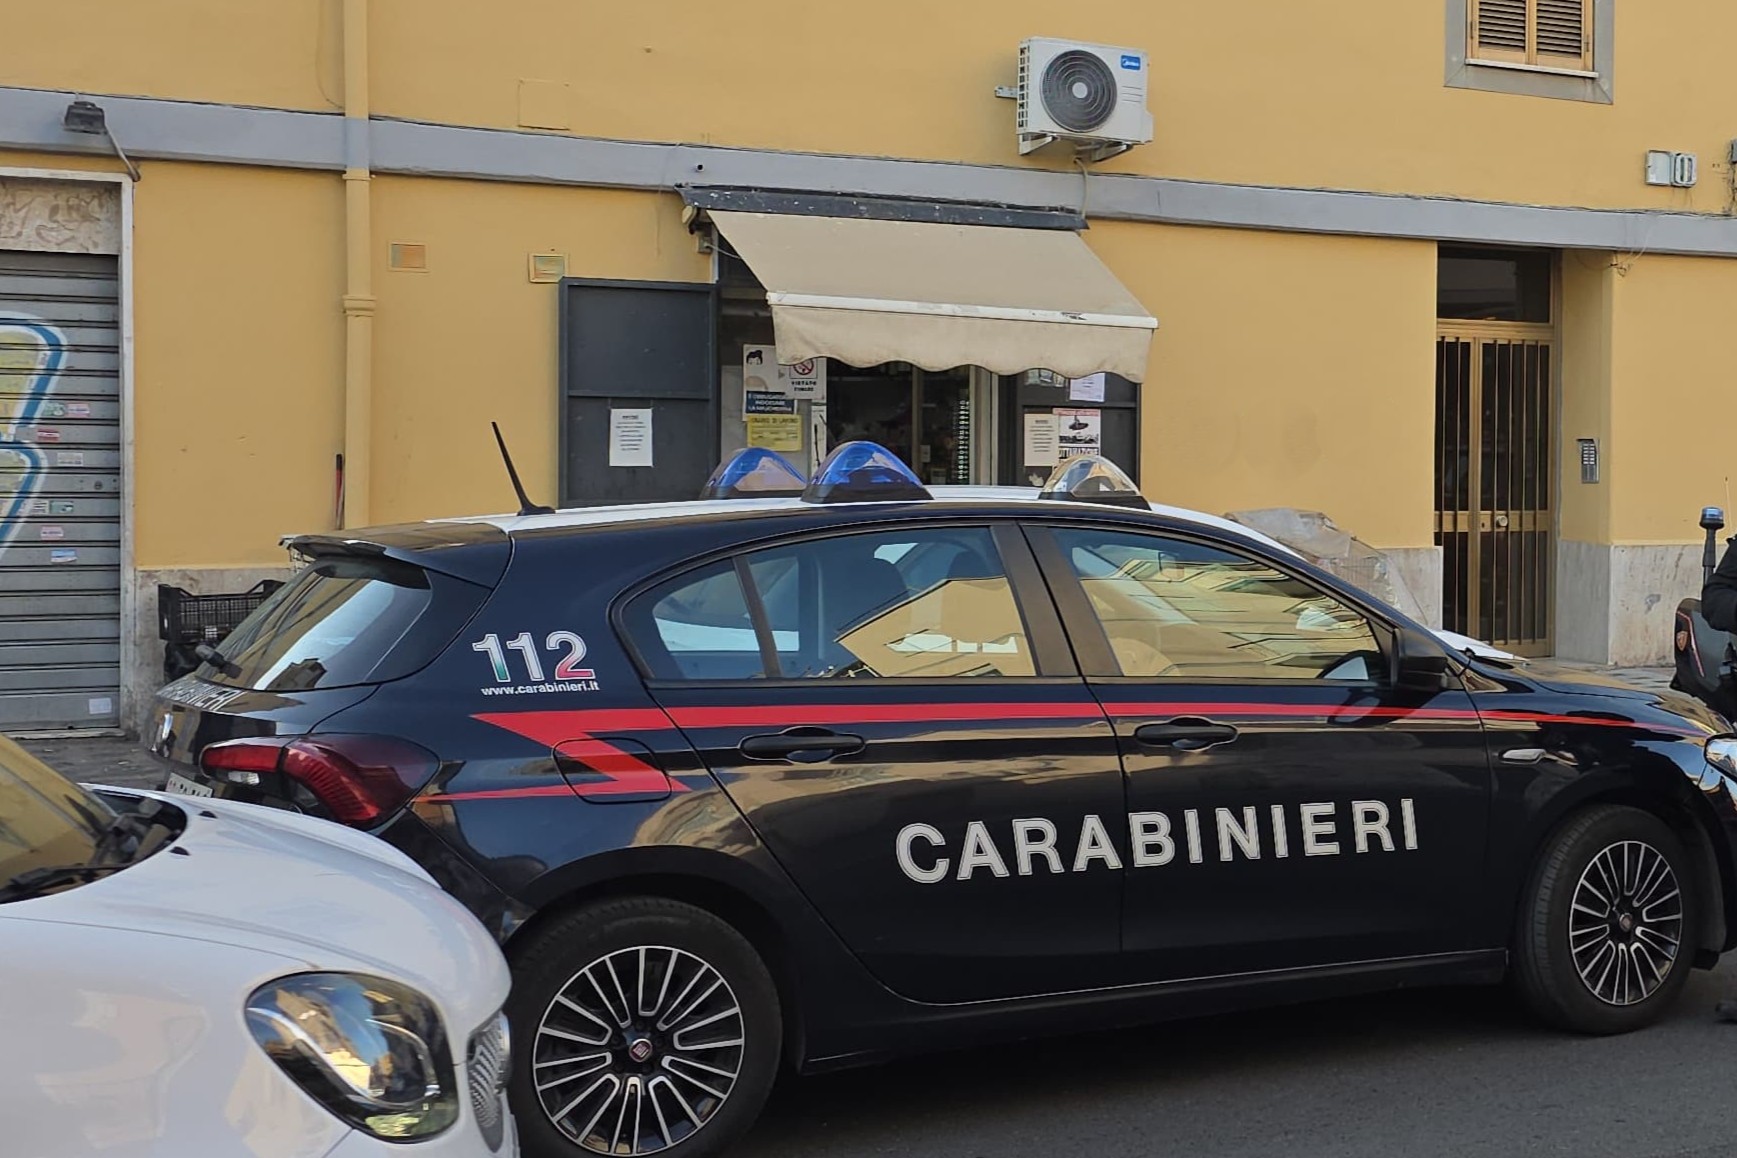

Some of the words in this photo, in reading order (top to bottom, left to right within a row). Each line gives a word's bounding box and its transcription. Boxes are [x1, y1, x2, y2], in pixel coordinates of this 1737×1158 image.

[472, 630, 596, 682] 112
[481, 681, 600, 696] www.carabinieri.it
[896, 798, 1418, 884] CARABINIERI
